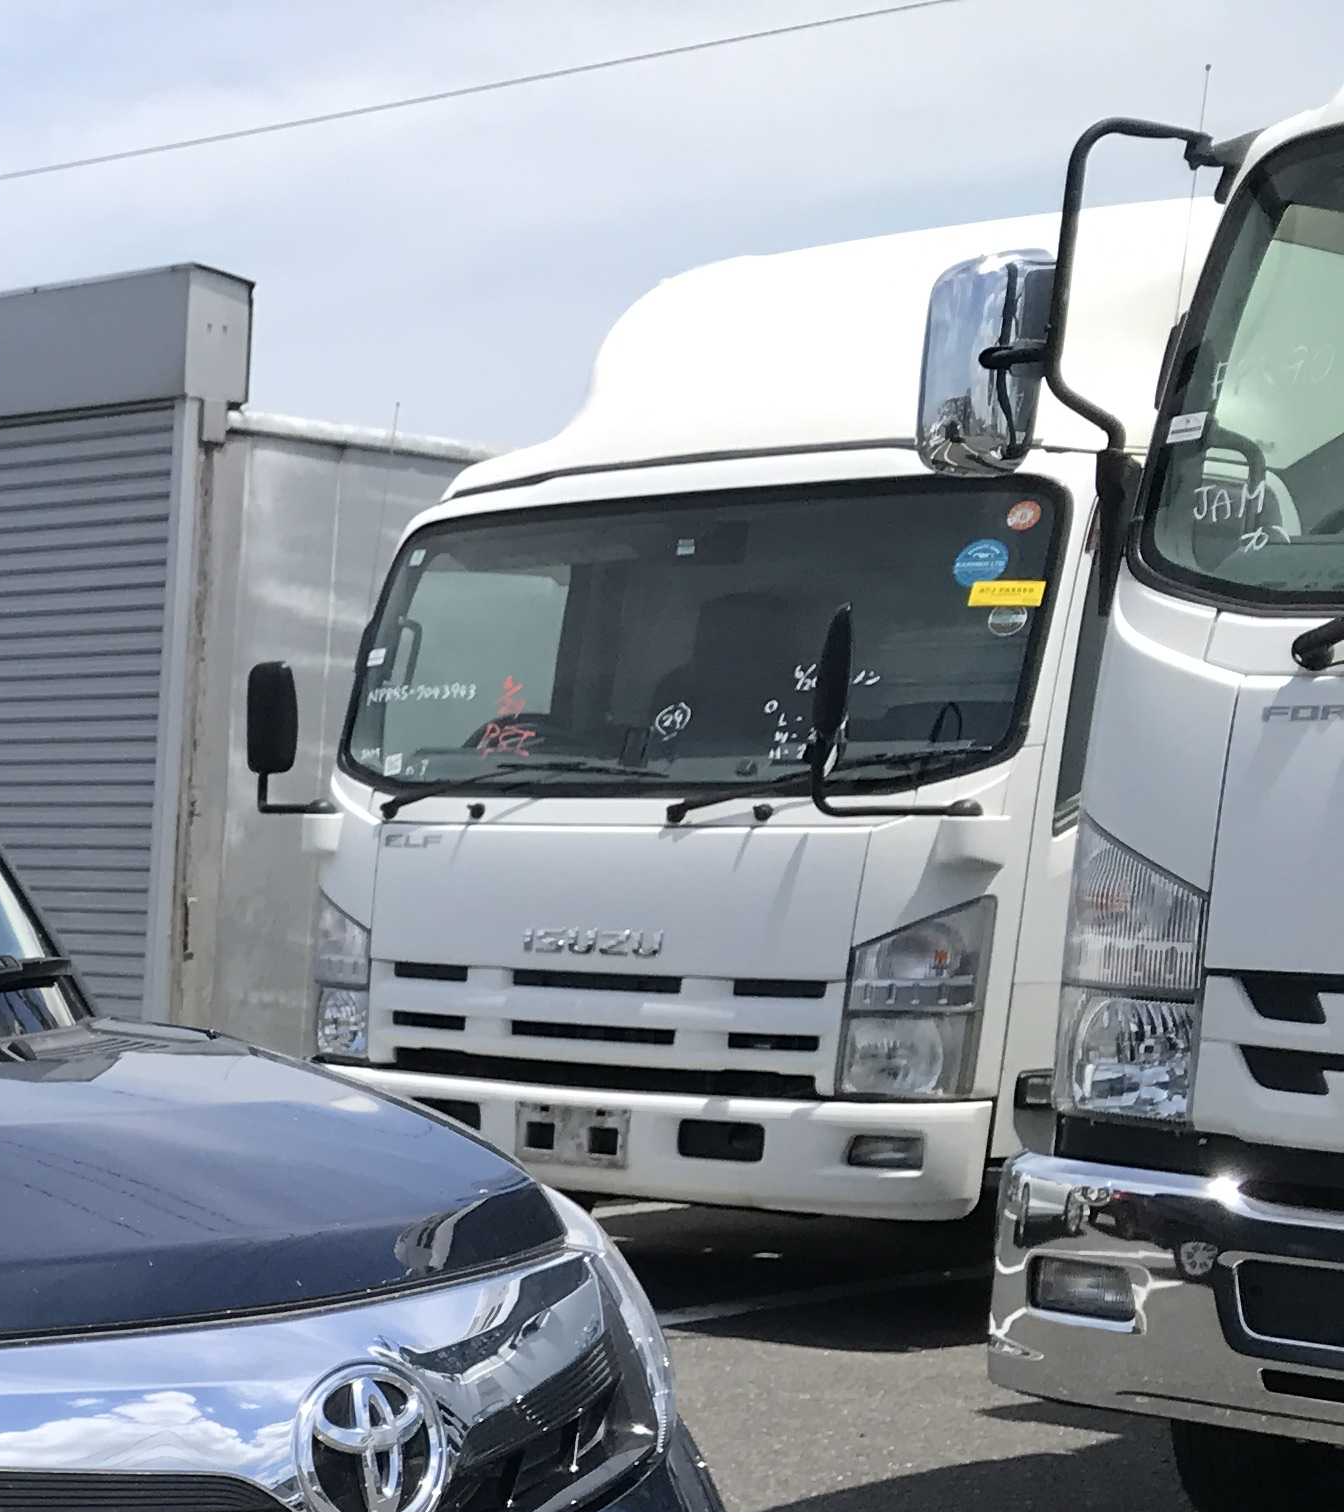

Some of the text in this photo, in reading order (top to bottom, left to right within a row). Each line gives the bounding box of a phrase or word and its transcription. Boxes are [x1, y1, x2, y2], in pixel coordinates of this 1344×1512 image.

[1192, 479, 1268, 523] JAM
[384, 833, 444, 849] ELF
[521, 926, 665, 959] ISUZU
